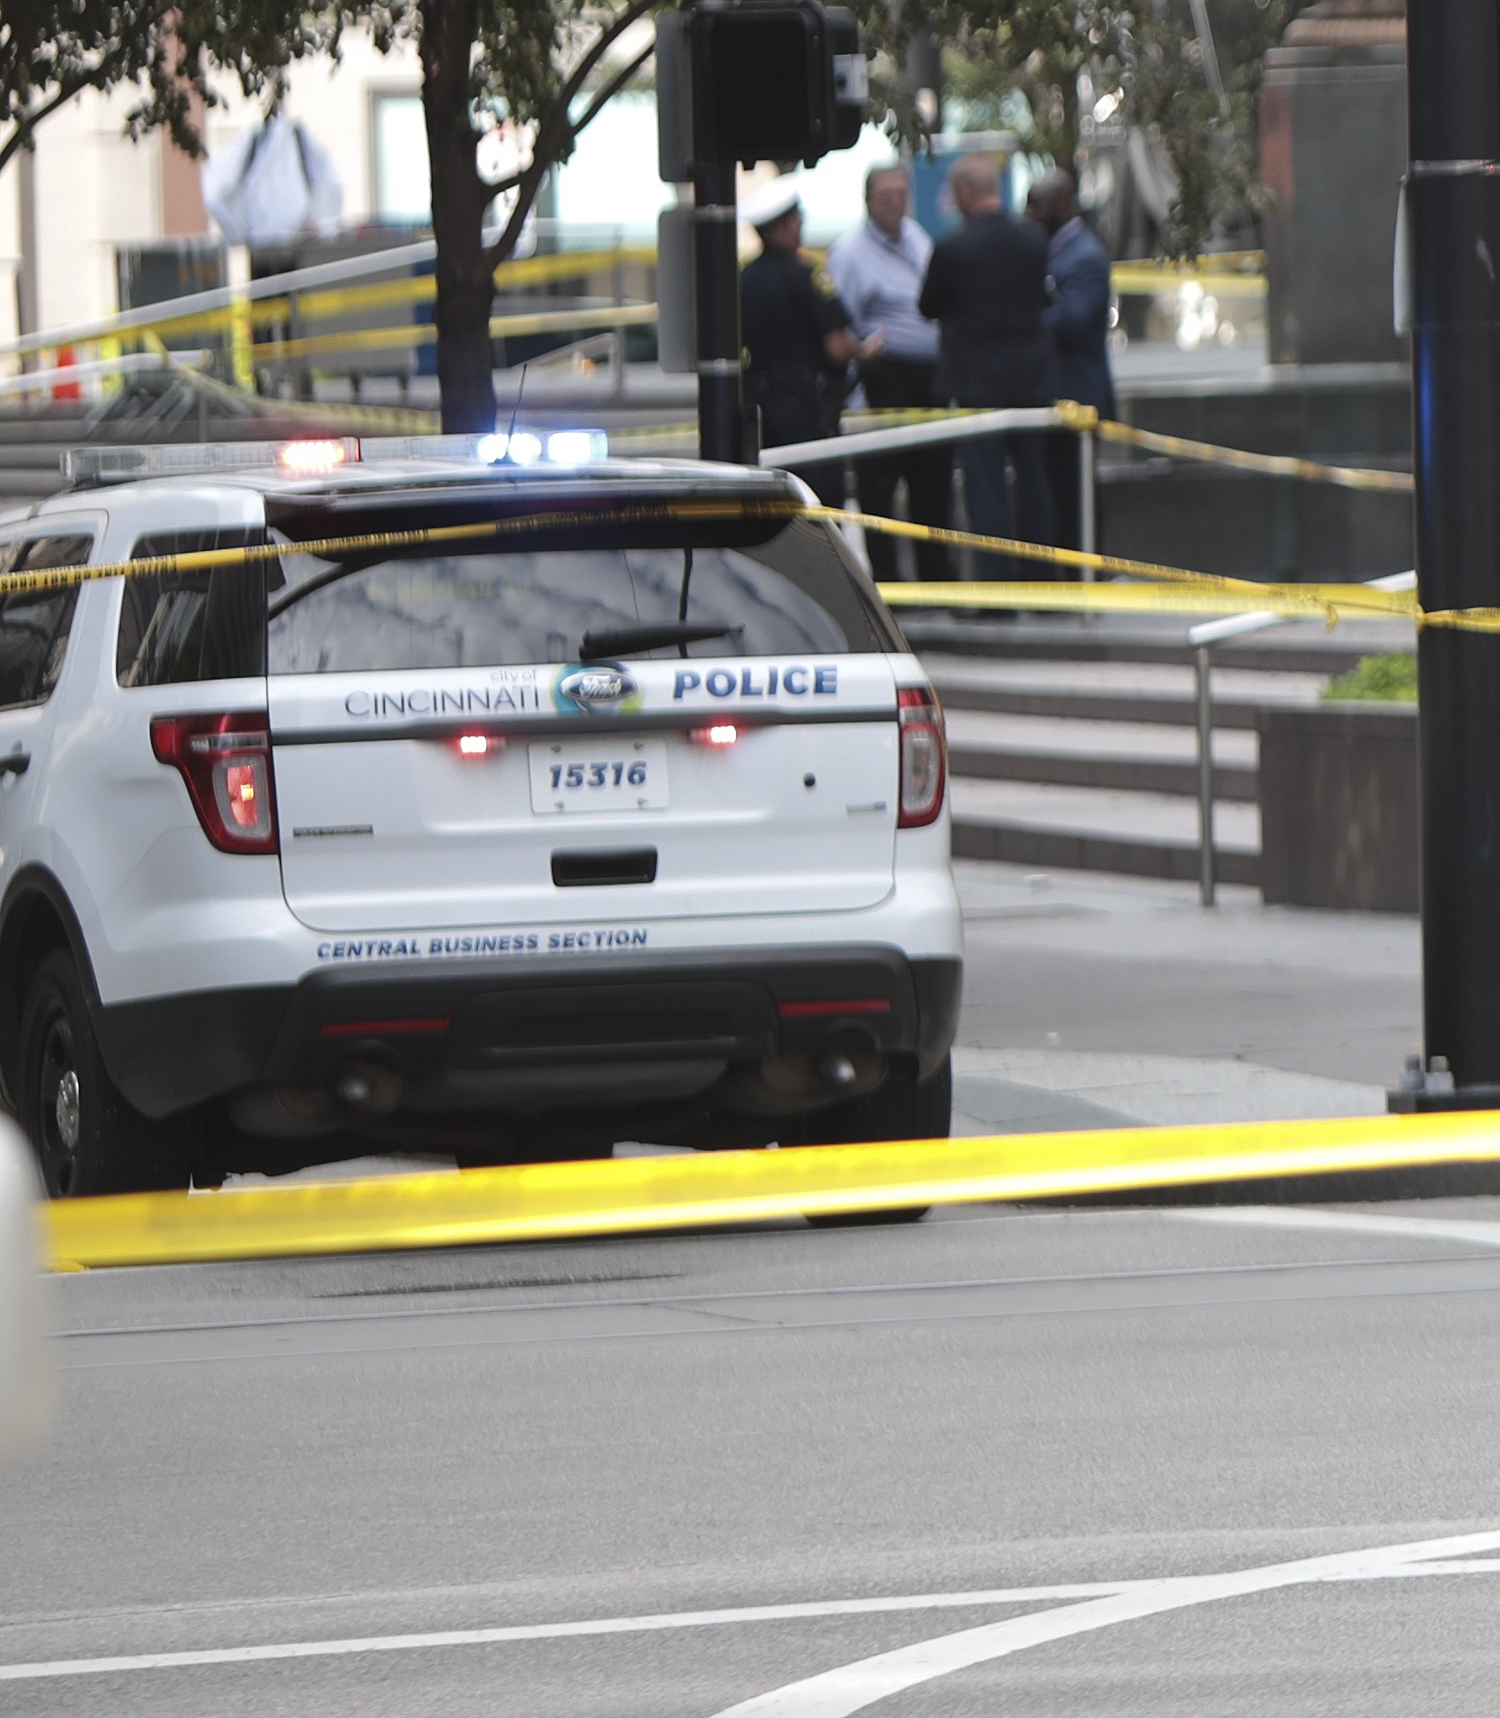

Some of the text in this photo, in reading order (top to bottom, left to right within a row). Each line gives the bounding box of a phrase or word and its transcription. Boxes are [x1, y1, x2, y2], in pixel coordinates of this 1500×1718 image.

[490, 668, 537, 683] city of
[673, 664, 838, 699] POLICE
[344, 684, 540, 718] CINCINNATI
[548, 759, 648, 789] 15316
[315, 927, 648, 960] CENTRAL BUSINESS SECTION
